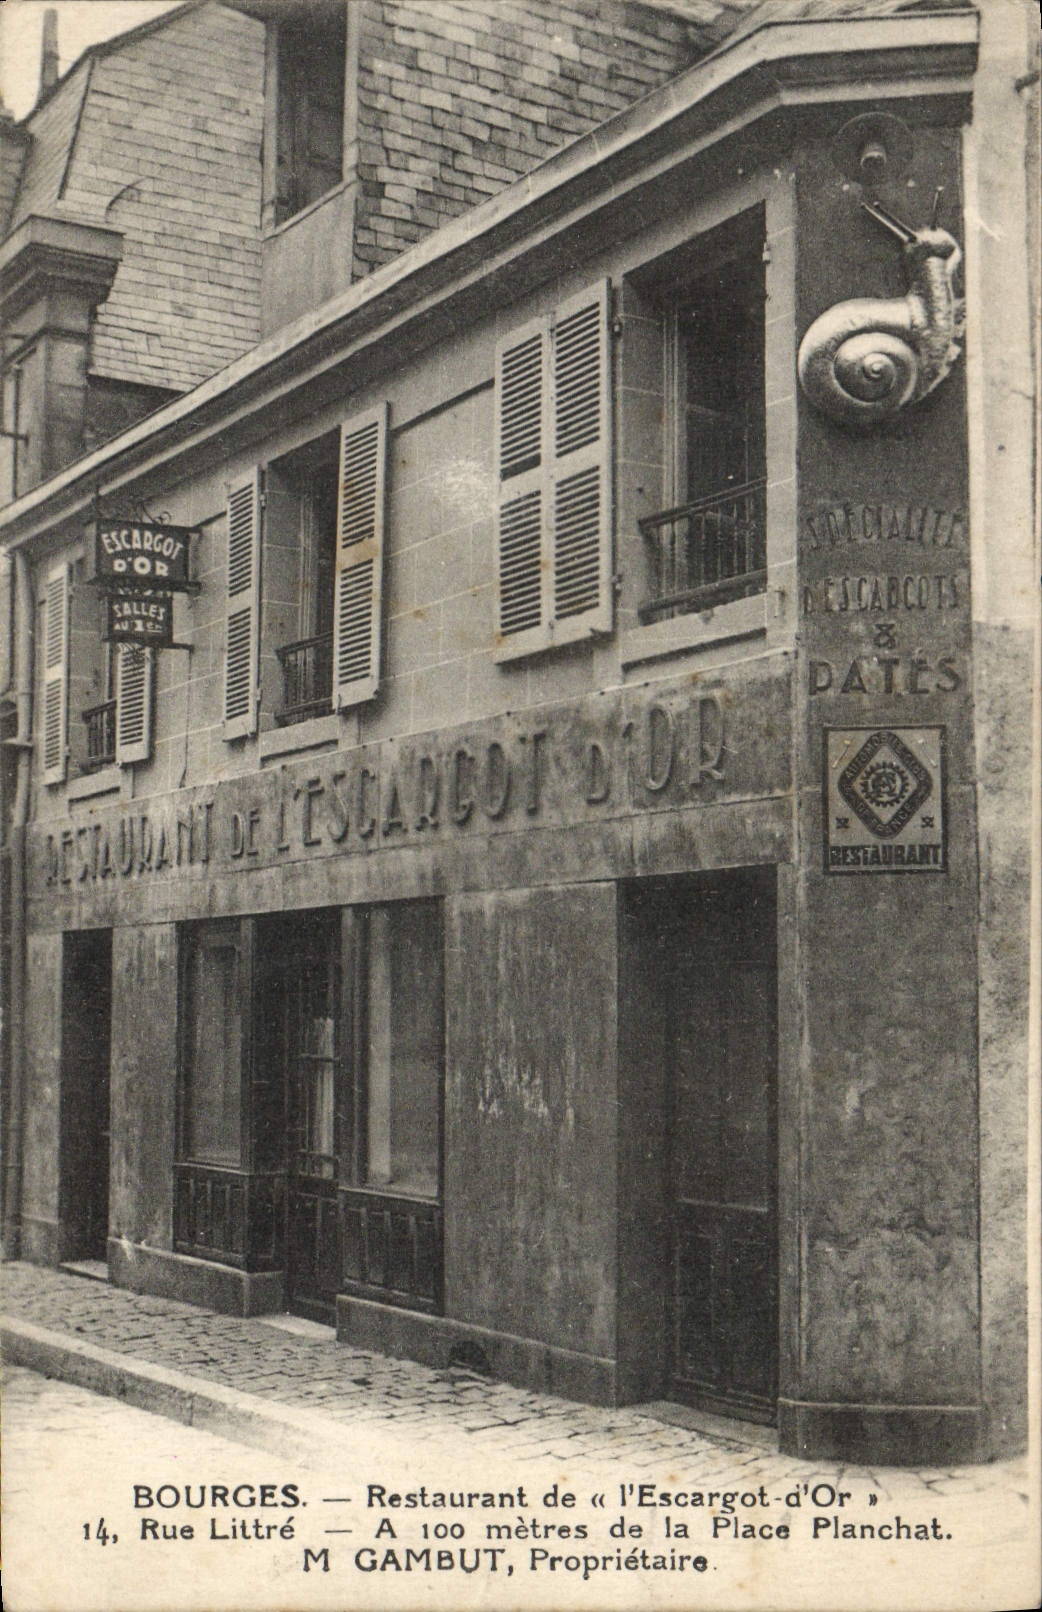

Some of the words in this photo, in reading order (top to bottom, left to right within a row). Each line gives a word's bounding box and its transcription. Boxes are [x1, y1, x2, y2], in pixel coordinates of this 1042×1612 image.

[101, 529, 184, 560] ESCARGOT
[112, 556, 169, 577] D'OR
[112, 602, 166, 621] SALLES
[45, 801, 214, 887] RESTAURANT
[230, 807, 261, 859] DE
[828, 844, 941, 866] RESTAURANT
